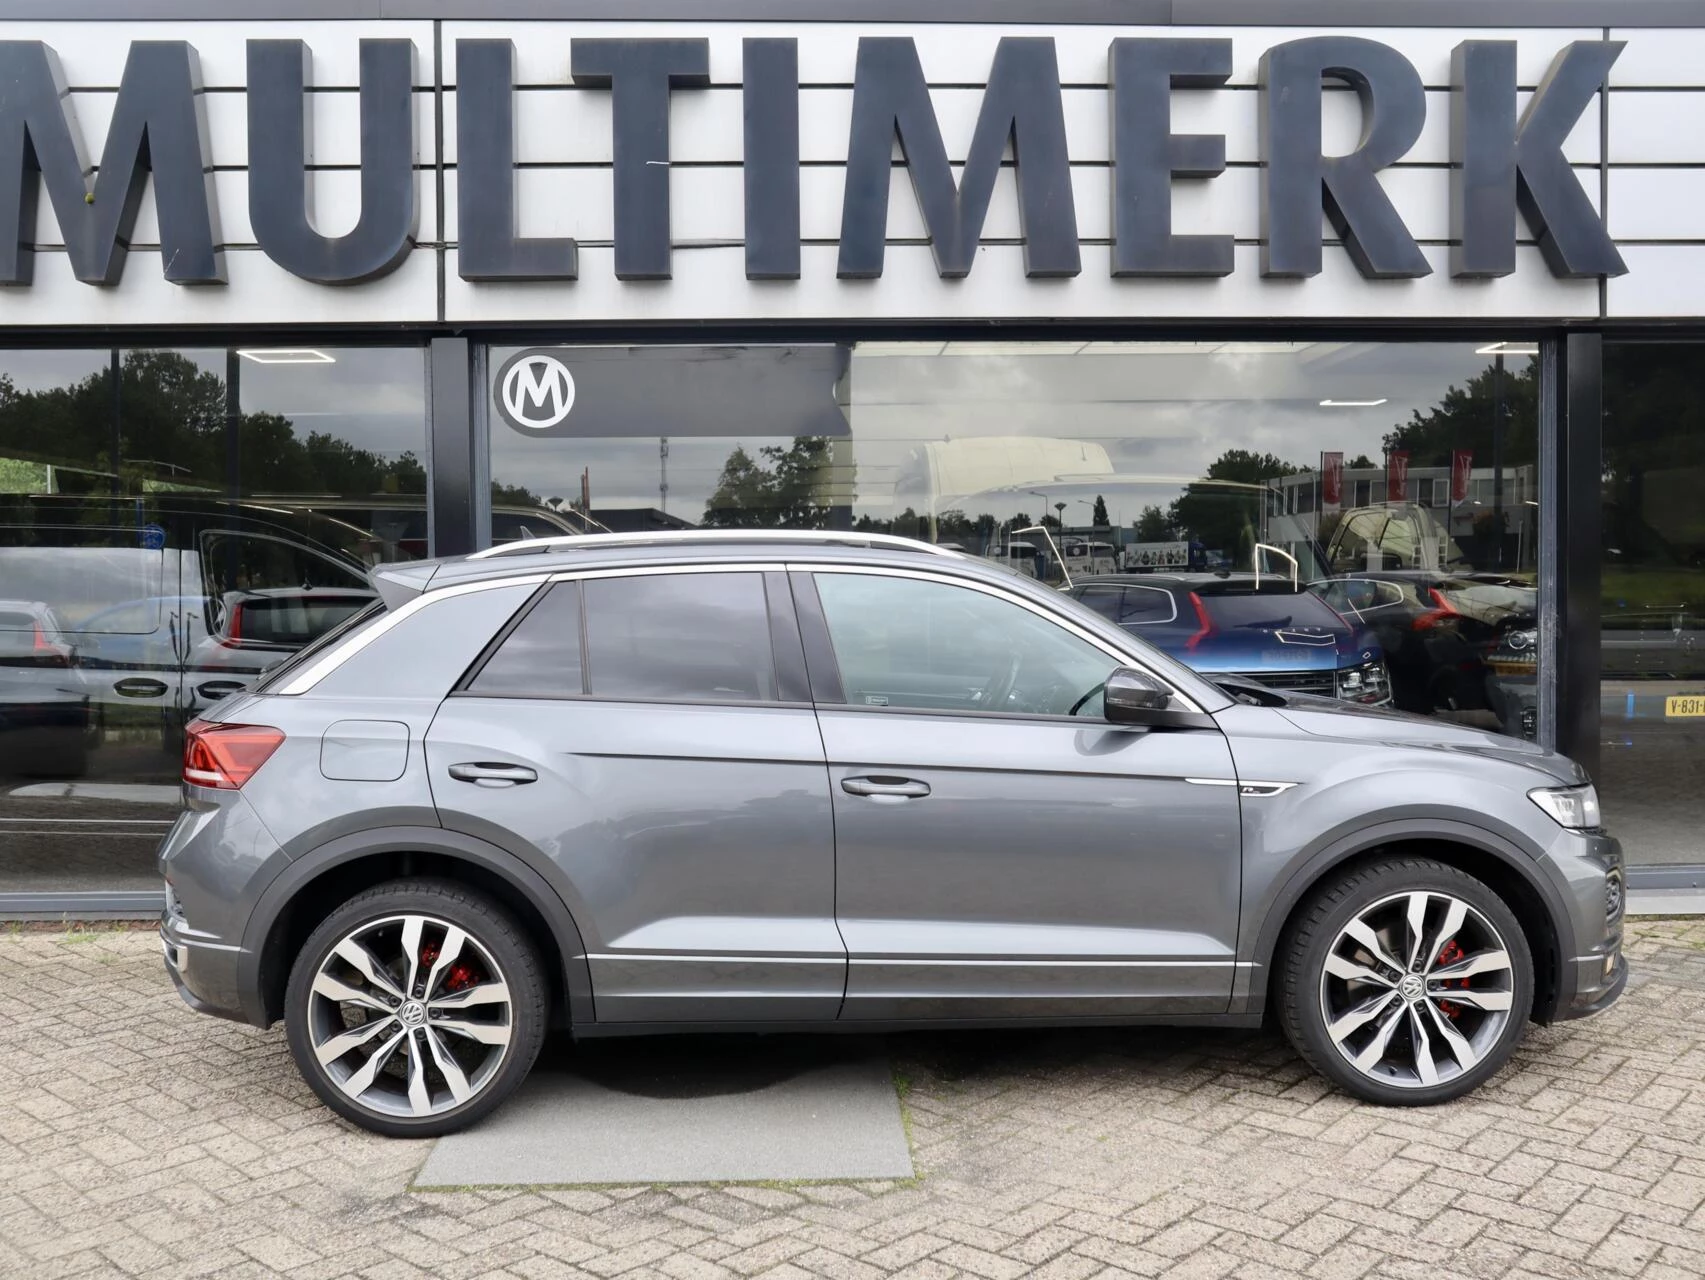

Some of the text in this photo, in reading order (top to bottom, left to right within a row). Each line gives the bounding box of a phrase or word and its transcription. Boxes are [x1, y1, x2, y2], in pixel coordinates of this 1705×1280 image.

[0, 37, 1630, 287] MULTIMERK
[508, 357, 570, 424] M
[1671, 699, 1705, 713] V-831-
